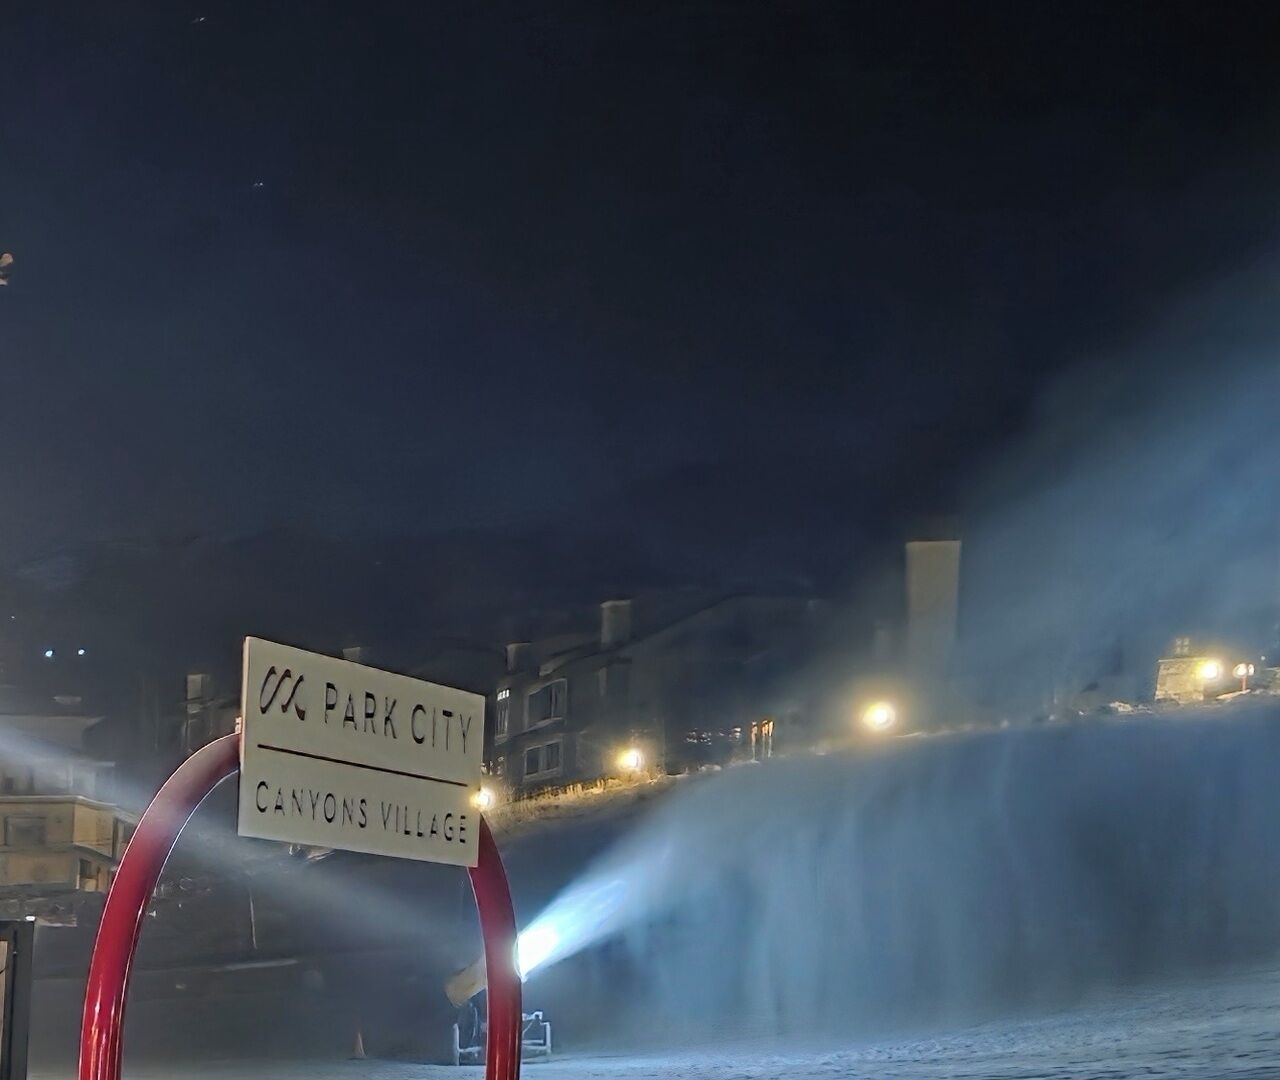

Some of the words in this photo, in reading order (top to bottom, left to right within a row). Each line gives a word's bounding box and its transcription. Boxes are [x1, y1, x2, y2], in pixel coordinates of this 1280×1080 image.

[324, 682, 398, 739] PARK
[410, 704, 472, 754] CITY
[255, 781, 368, 829] CANYONS
[380, 801, 467, 844] VILLAGE
